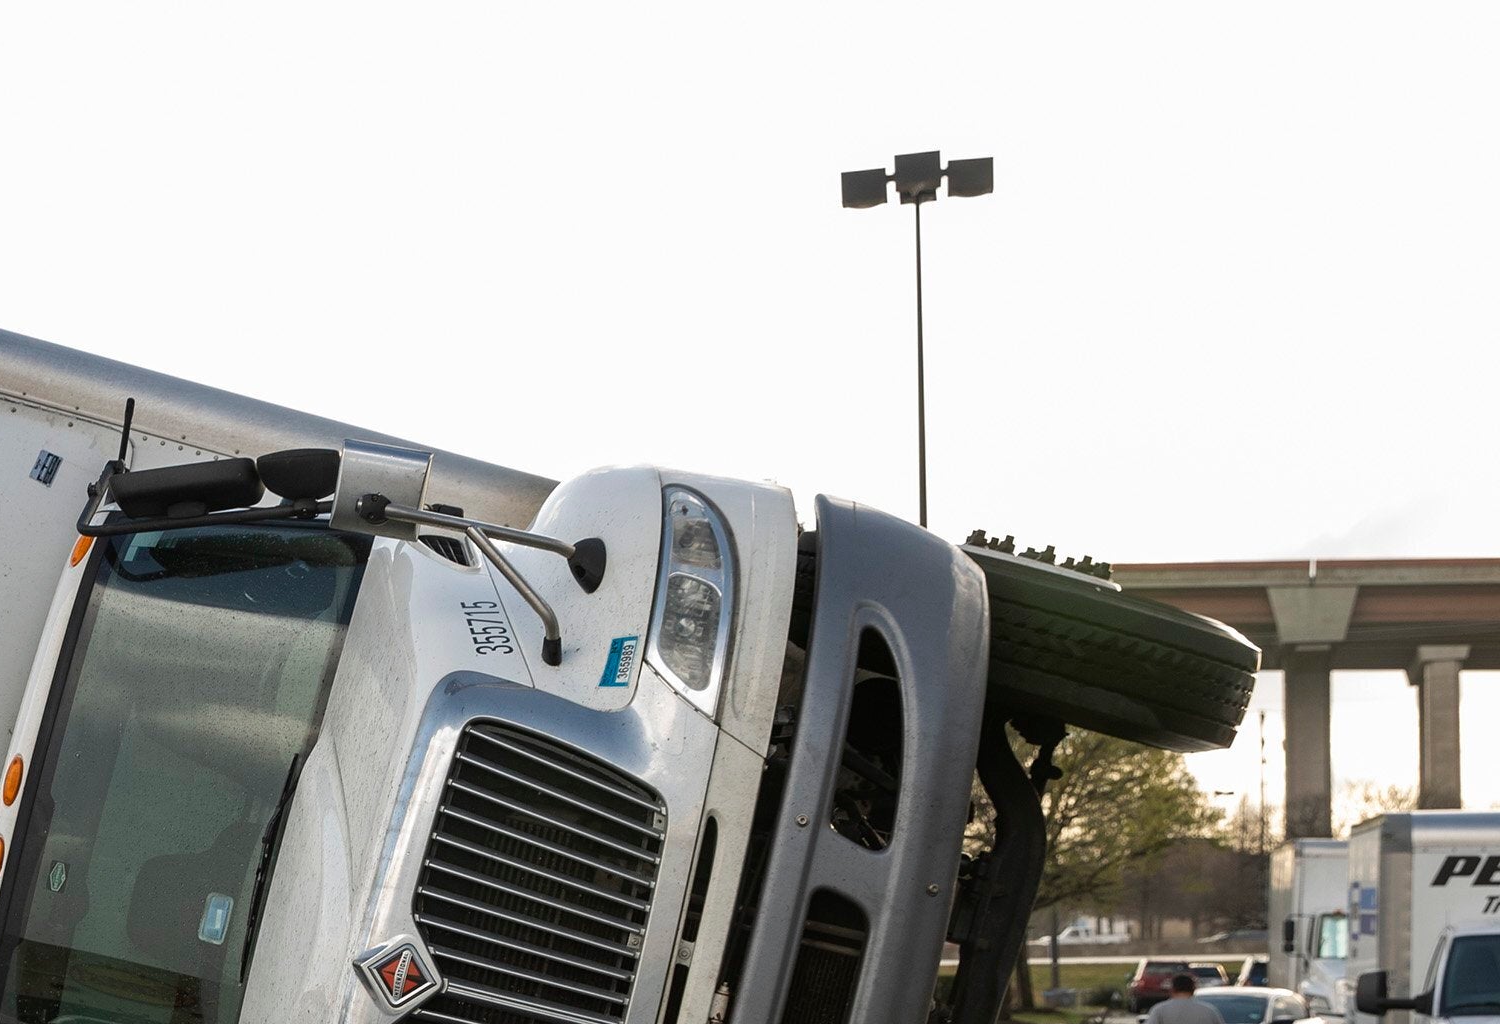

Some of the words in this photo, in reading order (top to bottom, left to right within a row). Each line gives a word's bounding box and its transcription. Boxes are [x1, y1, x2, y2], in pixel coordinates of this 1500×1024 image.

[461, 601, 513, 655] 355715
[617, 644, 635, 679] 365989
[393, 952, 409, 998] INTERNATIONAL
